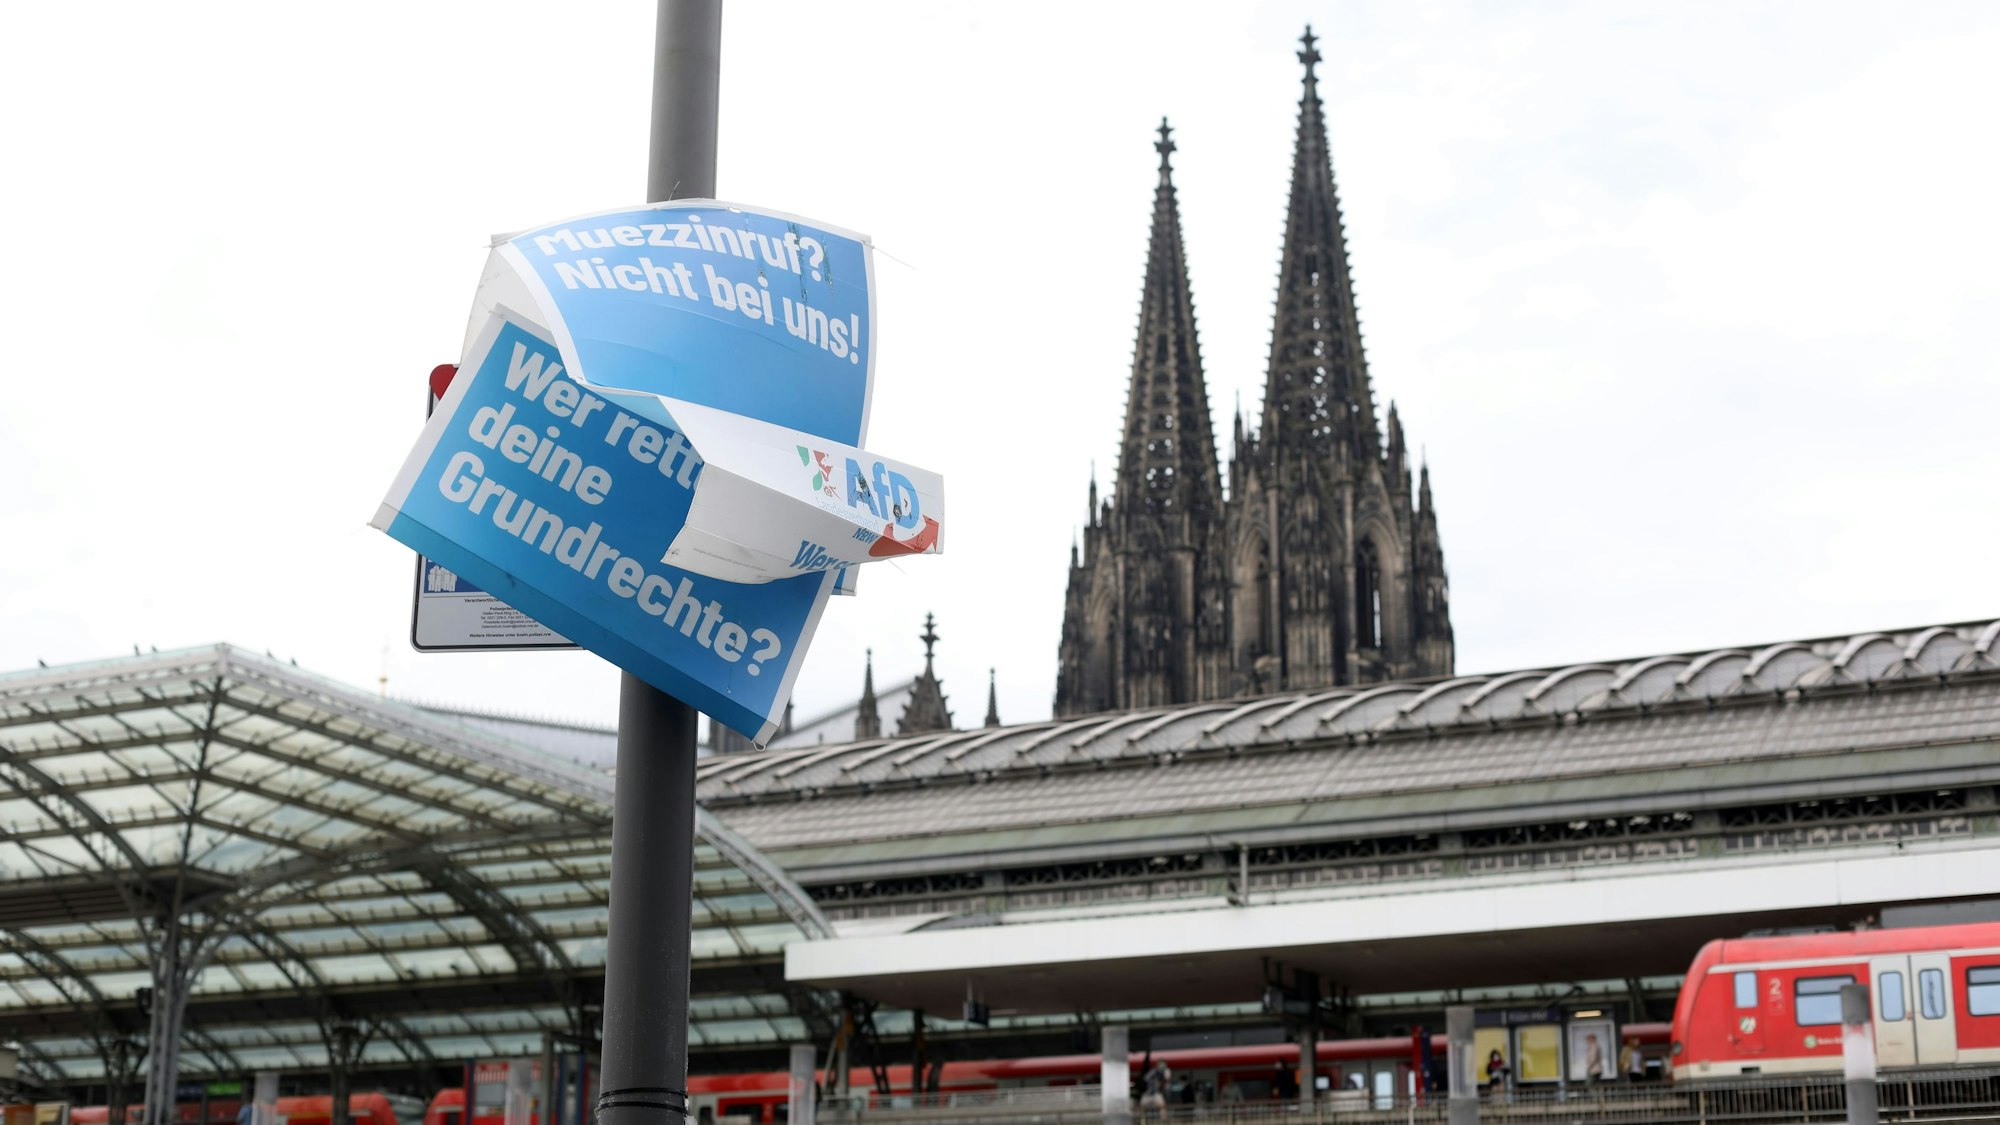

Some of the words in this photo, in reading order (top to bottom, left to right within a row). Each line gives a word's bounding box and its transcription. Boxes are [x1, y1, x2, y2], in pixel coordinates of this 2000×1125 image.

[533, 215, 825, 282] Muezzinruf?
[553, 257, 699, 301] Nicht
[702, 264, 774, 326] bei
[782, 297, 859, 365] uns!
[468, 402, 613, 505] deine
[504, 341, 606, 428] Wer
[604, 411, 704, 491] rett
[845, 457, 920, 530] AfD
[852, 527, 879, 544] NRW
[438, 451, 782, 677] Grundrechte?
[1769, 977, 1782, 994] 2
